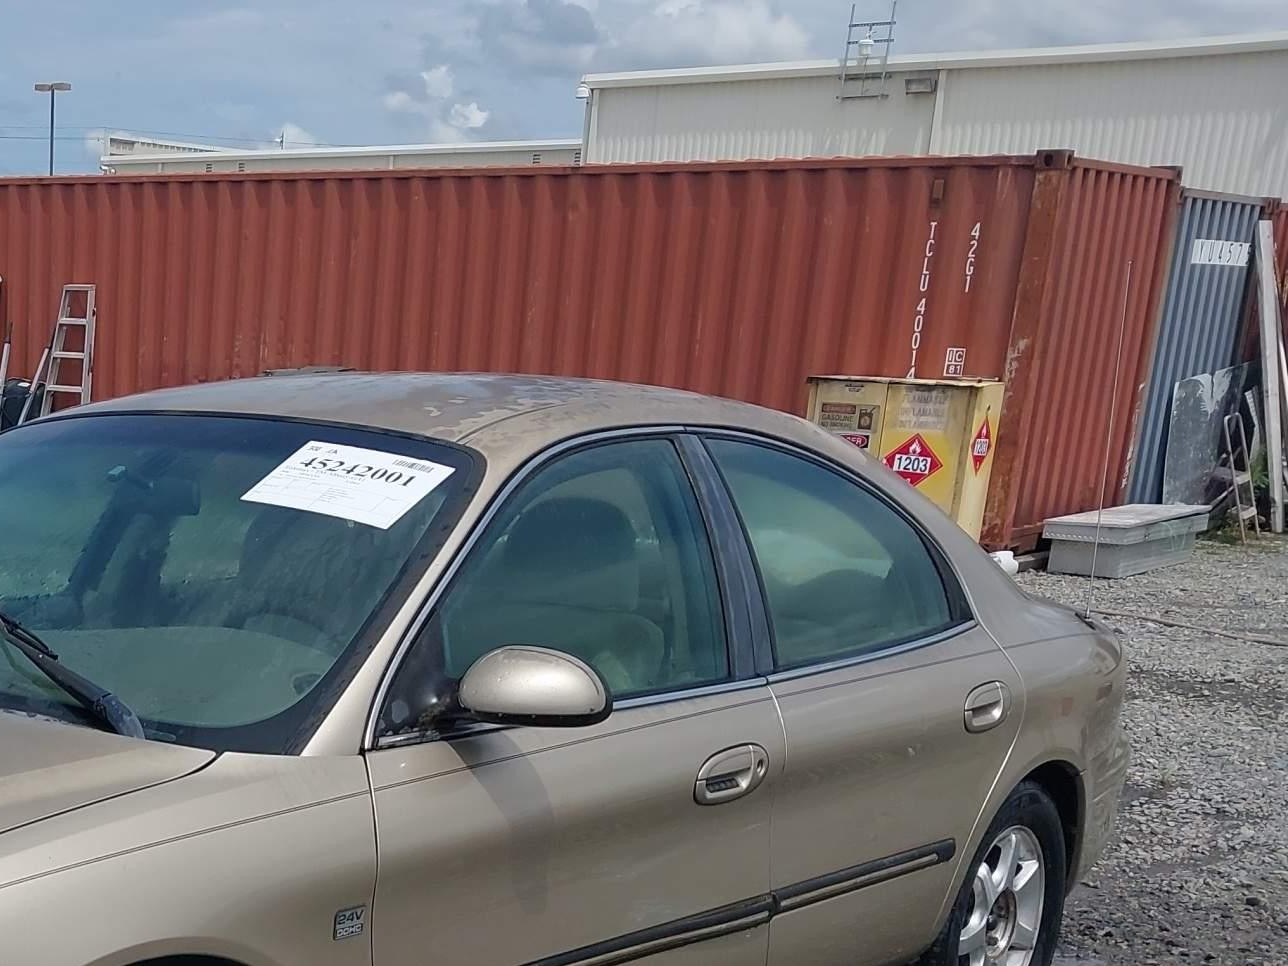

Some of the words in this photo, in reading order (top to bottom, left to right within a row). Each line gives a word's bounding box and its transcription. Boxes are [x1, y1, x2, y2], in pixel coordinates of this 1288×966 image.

[919, 221, 938, 292] TCLU
[964, 222, 981, 293] 42G1
[947, 363, 961, 375] 81
[299, 457, 416, 487] 45242001
[895, 456, 928, 473] 1203
[338, 909, 364, 925] 24V
